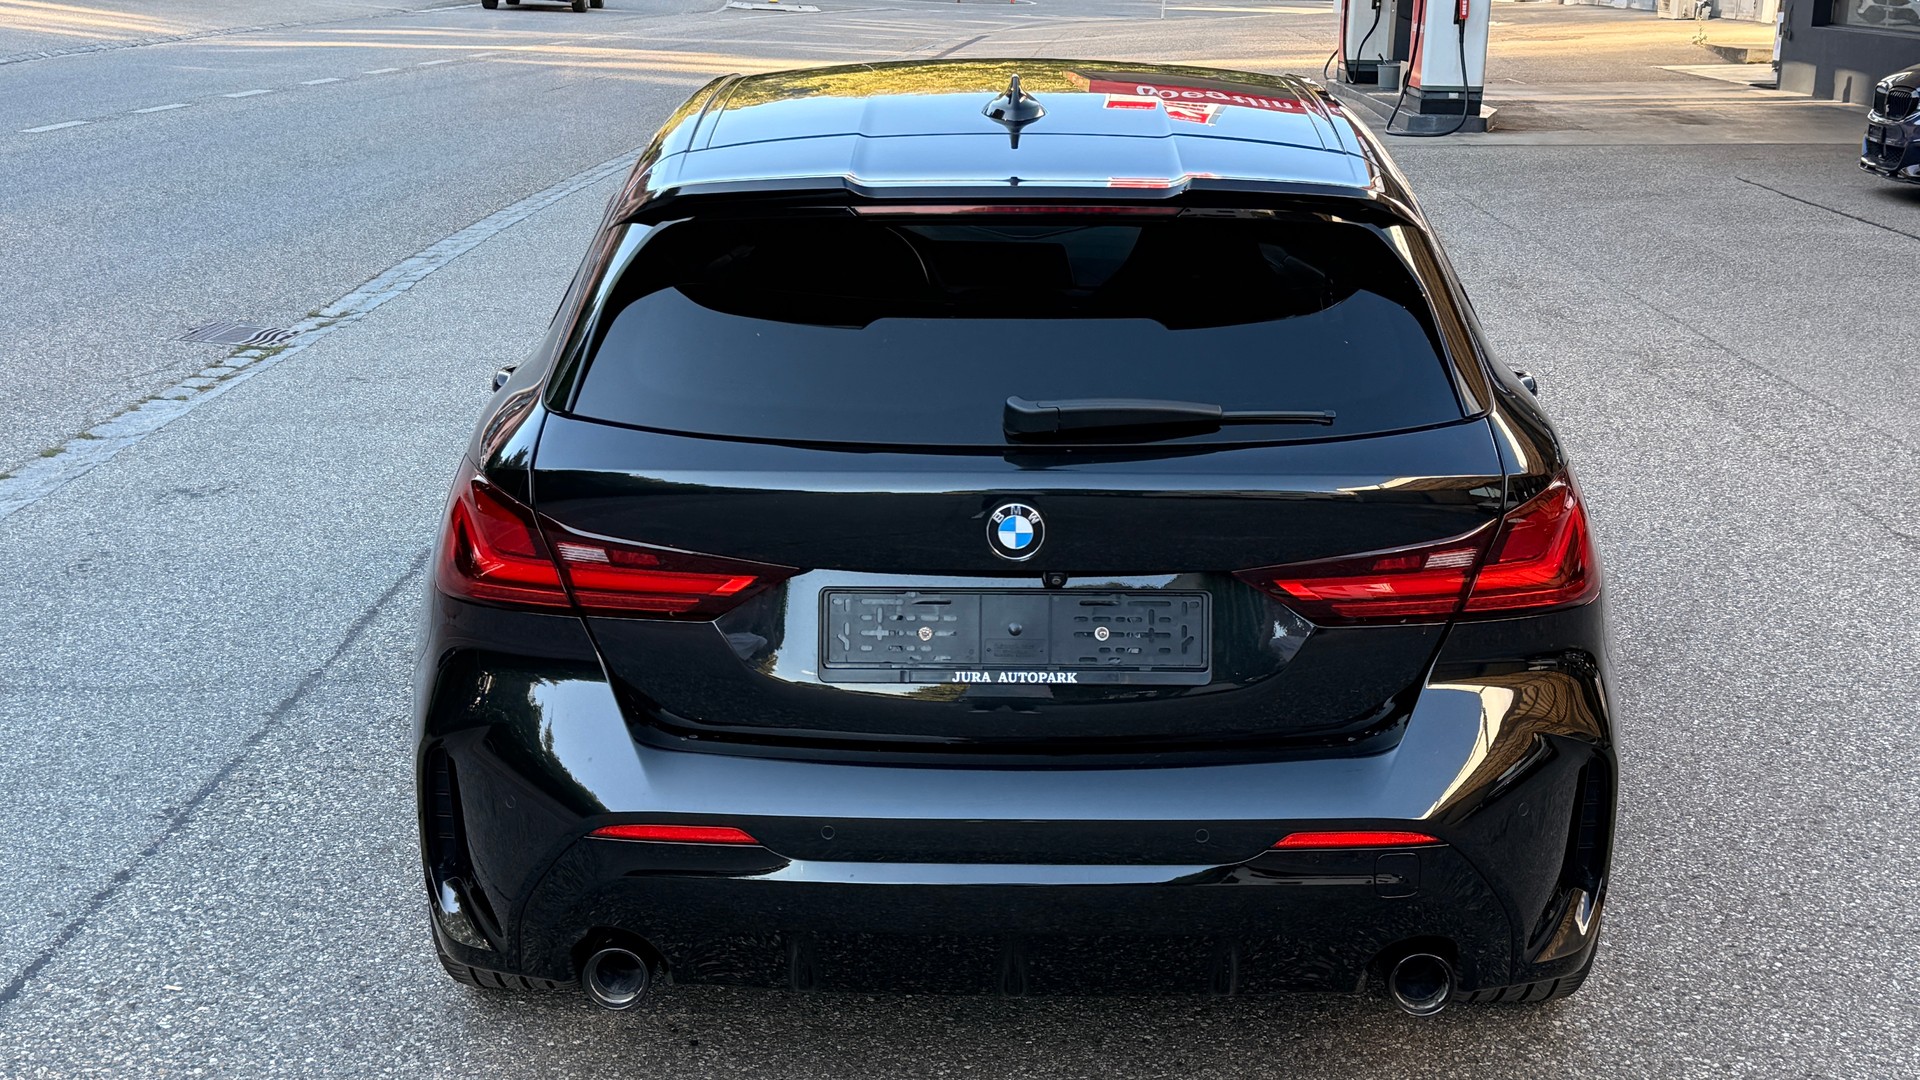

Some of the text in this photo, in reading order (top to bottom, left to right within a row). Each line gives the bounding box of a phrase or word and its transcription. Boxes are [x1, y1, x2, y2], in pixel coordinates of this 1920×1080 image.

[991, 505, 1040, 524] BMW
[952, 671, 1078, 684] JURA AUTOPARK
